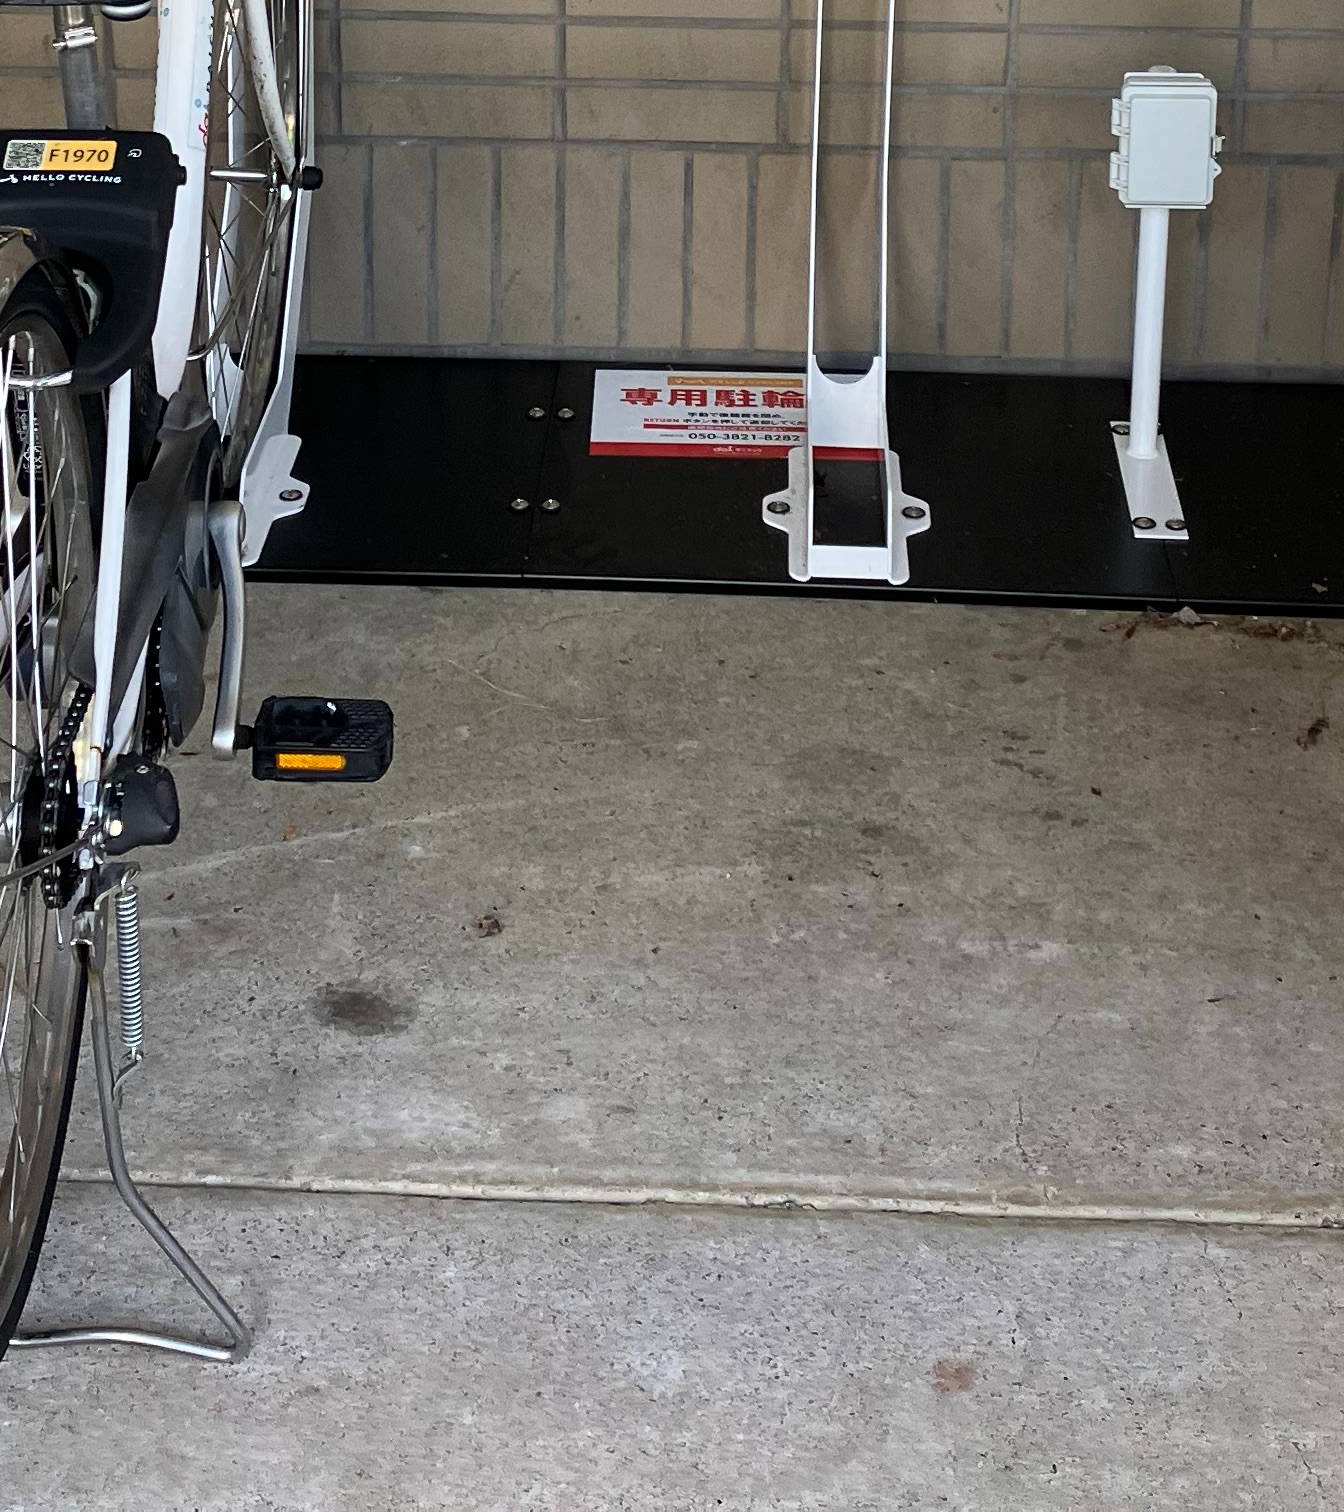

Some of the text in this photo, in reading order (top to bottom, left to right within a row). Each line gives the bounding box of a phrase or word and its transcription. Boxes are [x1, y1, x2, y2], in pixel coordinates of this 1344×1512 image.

[49, 149, 109, 163] F1970
[68, 174, 122, 183] CYCLING
[688, 432, 801, 442] 050-3821-8282
